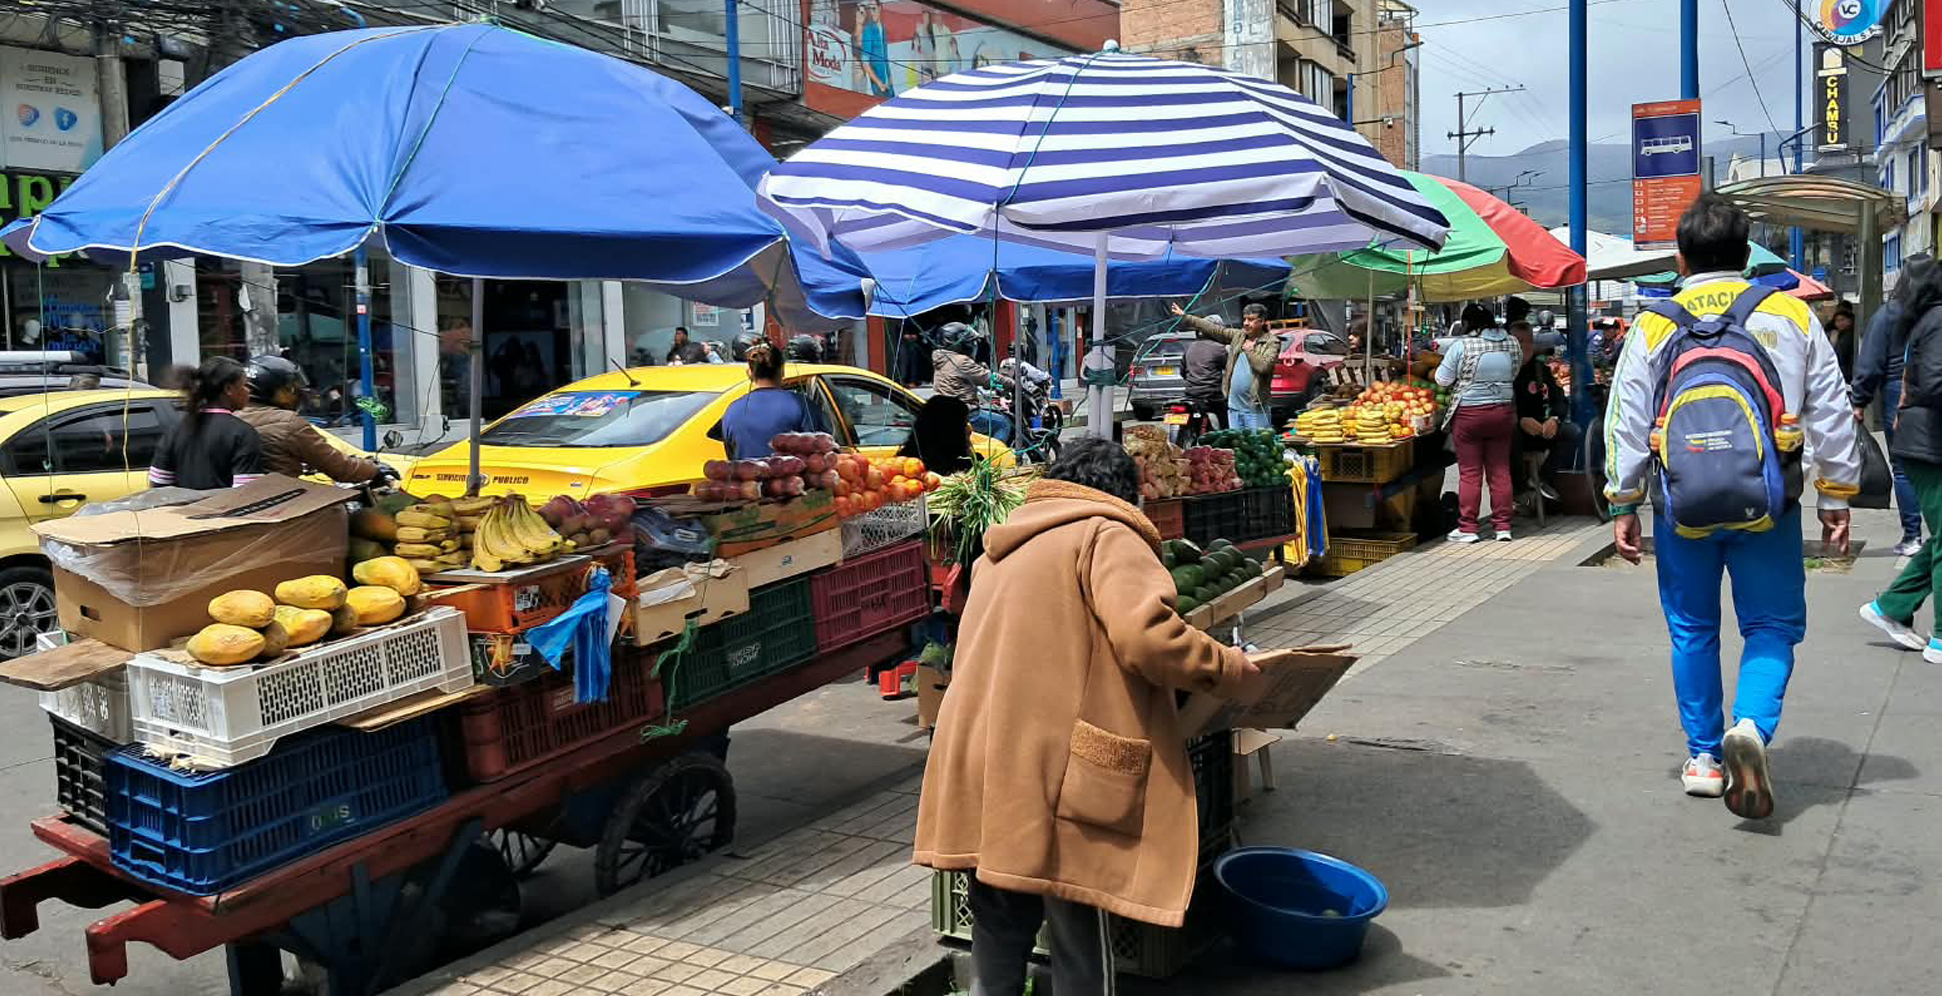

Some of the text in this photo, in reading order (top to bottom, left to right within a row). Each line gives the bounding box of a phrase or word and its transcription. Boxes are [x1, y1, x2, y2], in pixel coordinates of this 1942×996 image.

[812, 48, 842, 72] Moda
[436, 473, 467, 483] SERVICIO
[492, 475, 529, 485] PUBLICO
